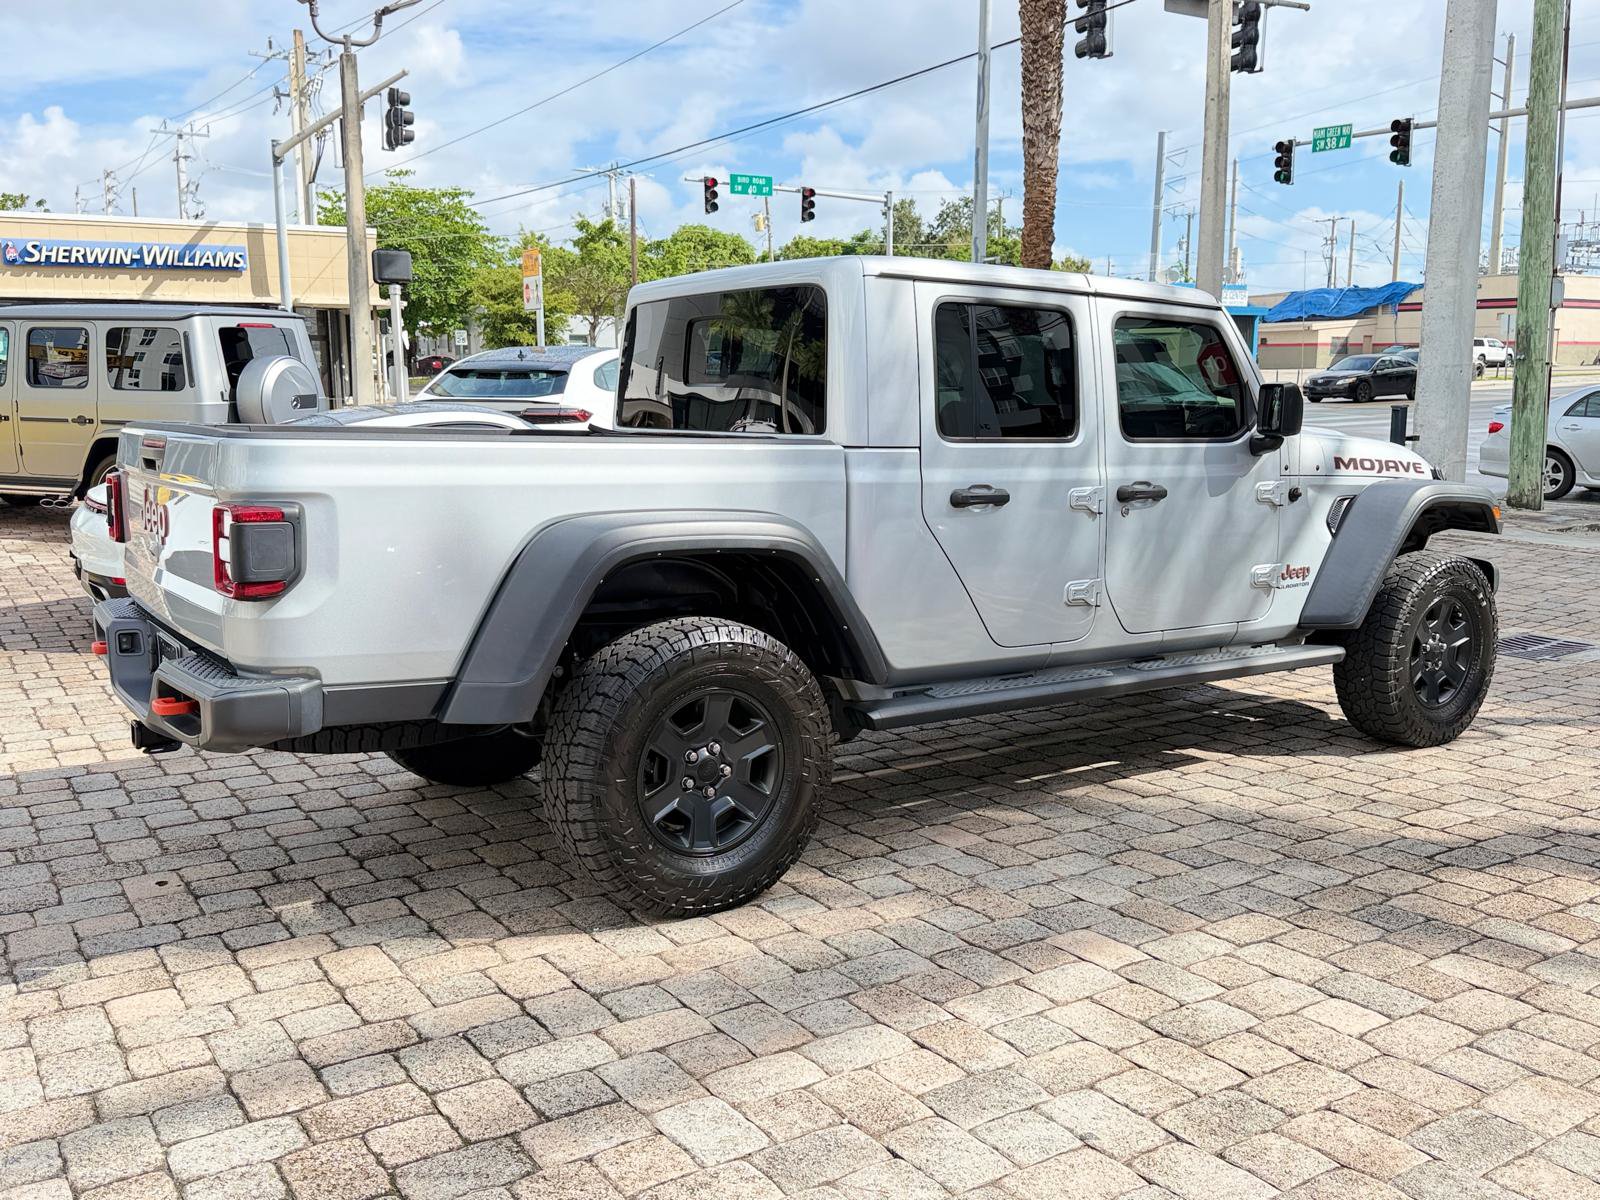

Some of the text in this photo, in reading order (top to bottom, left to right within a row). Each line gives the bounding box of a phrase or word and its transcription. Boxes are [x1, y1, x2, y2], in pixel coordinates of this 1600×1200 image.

[1326, 127, 1341, 138] GREEN
[1341, 125, 1351, 135] WAY
[1316, 137, 1348, 151] SW 38 AV
[737, 176, 766, 185] BIRD ROAD
[748, 185, 757, 194] 40
[24, 240, 244, 268] SHERWIN-WILLIAMS
[1333, 456, 1425, 474] MOJAVE
[141, 487, 170, 546] Jeep
[1281, 564, 1310, 581] Jeep
